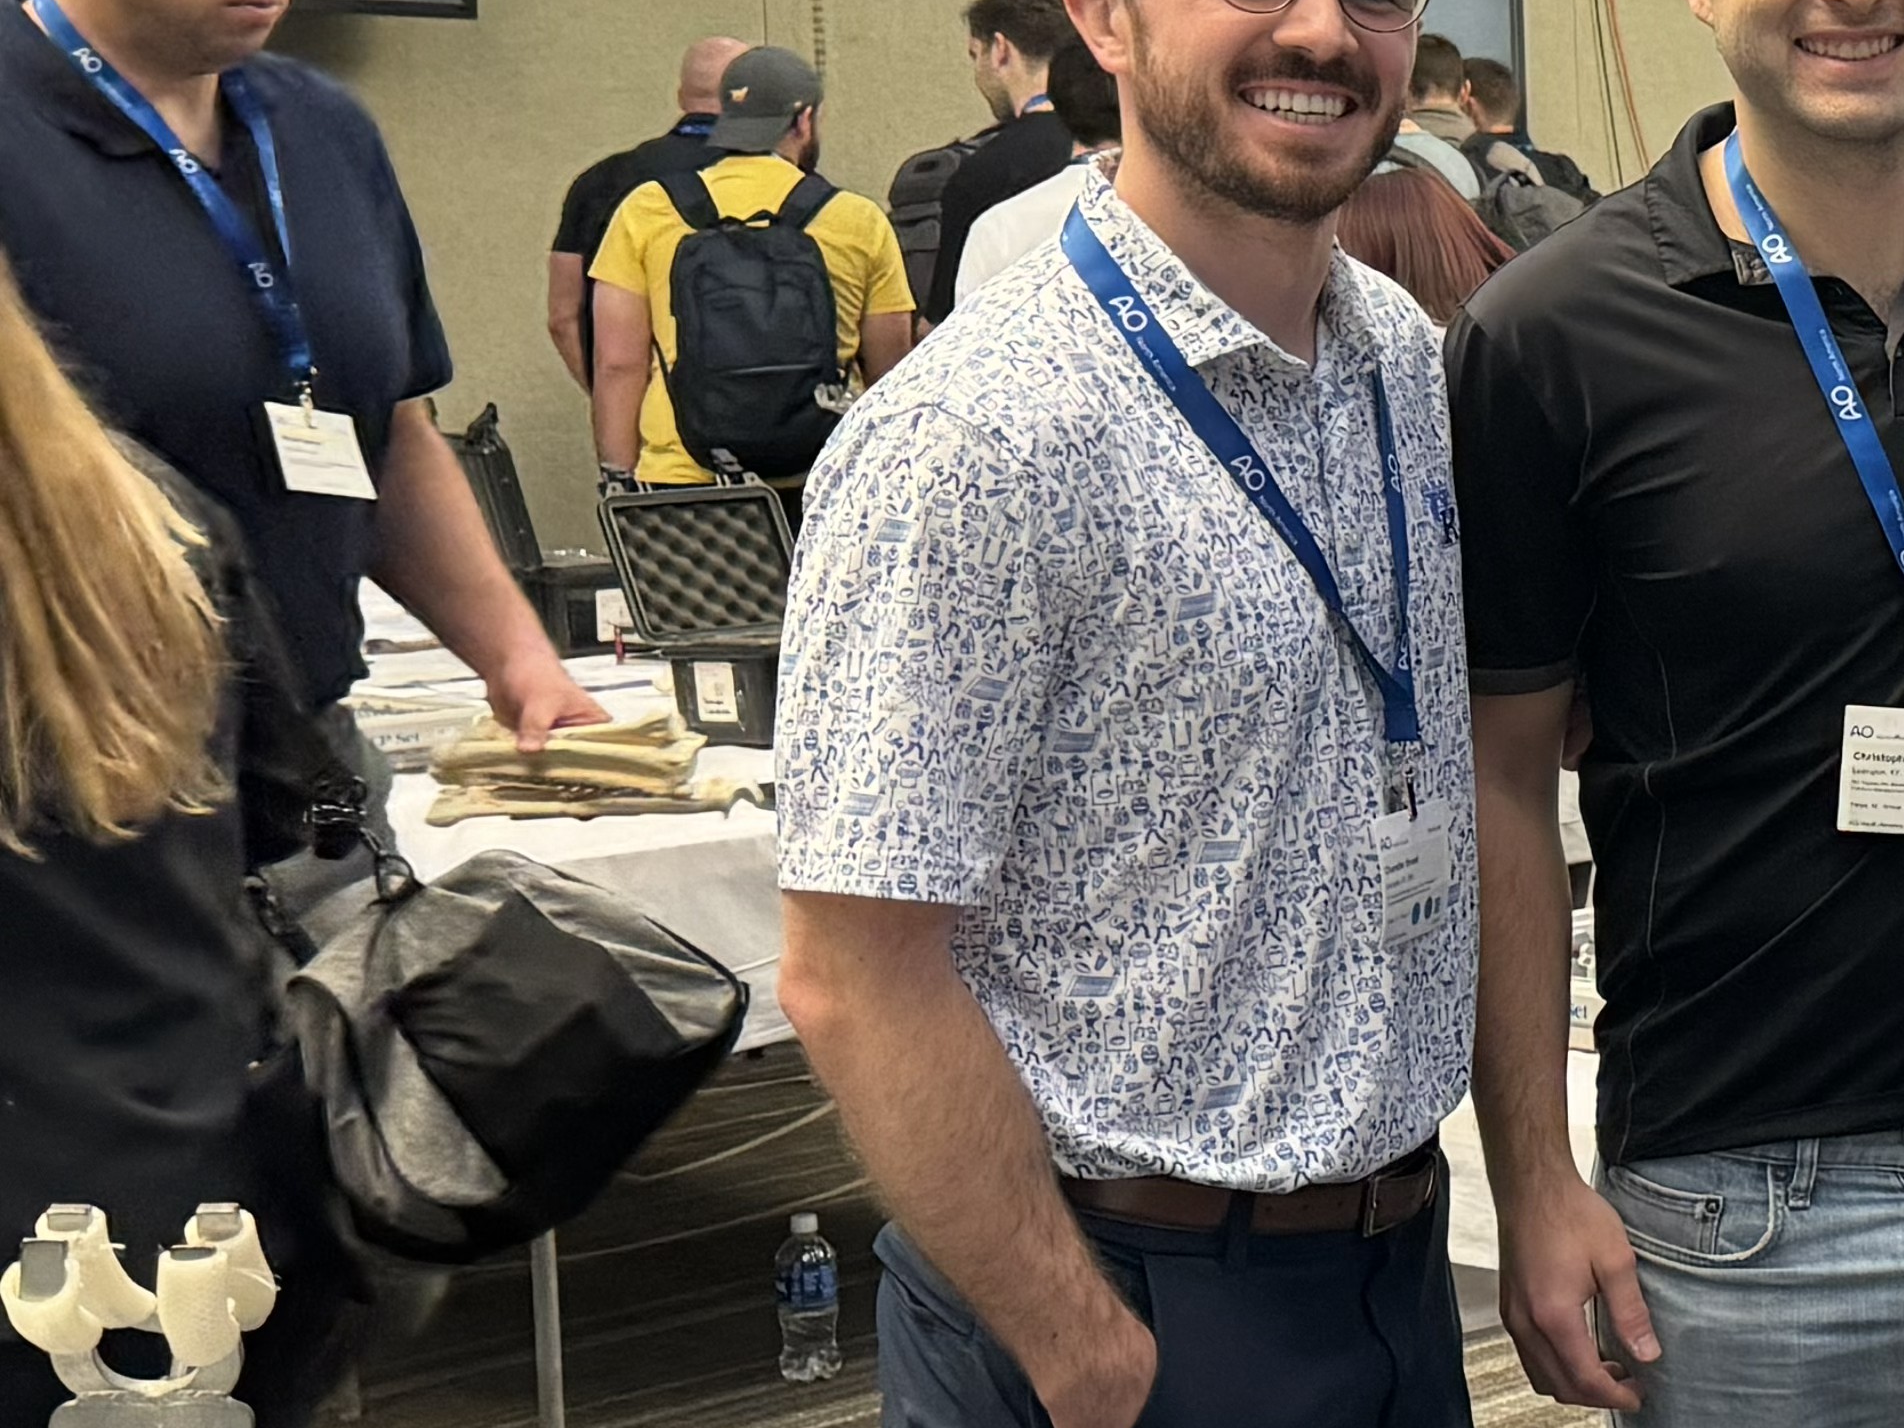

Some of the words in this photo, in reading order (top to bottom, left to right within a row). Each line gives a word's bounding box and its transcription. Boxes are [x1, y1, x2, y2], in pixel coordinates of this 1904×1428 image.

[1761, 234, 1793, 264] AO
[1109, 295, 1149, 332] AO
[1830, 385, 1863, 420] AO
[1230, 455, 1266, 492] AO
